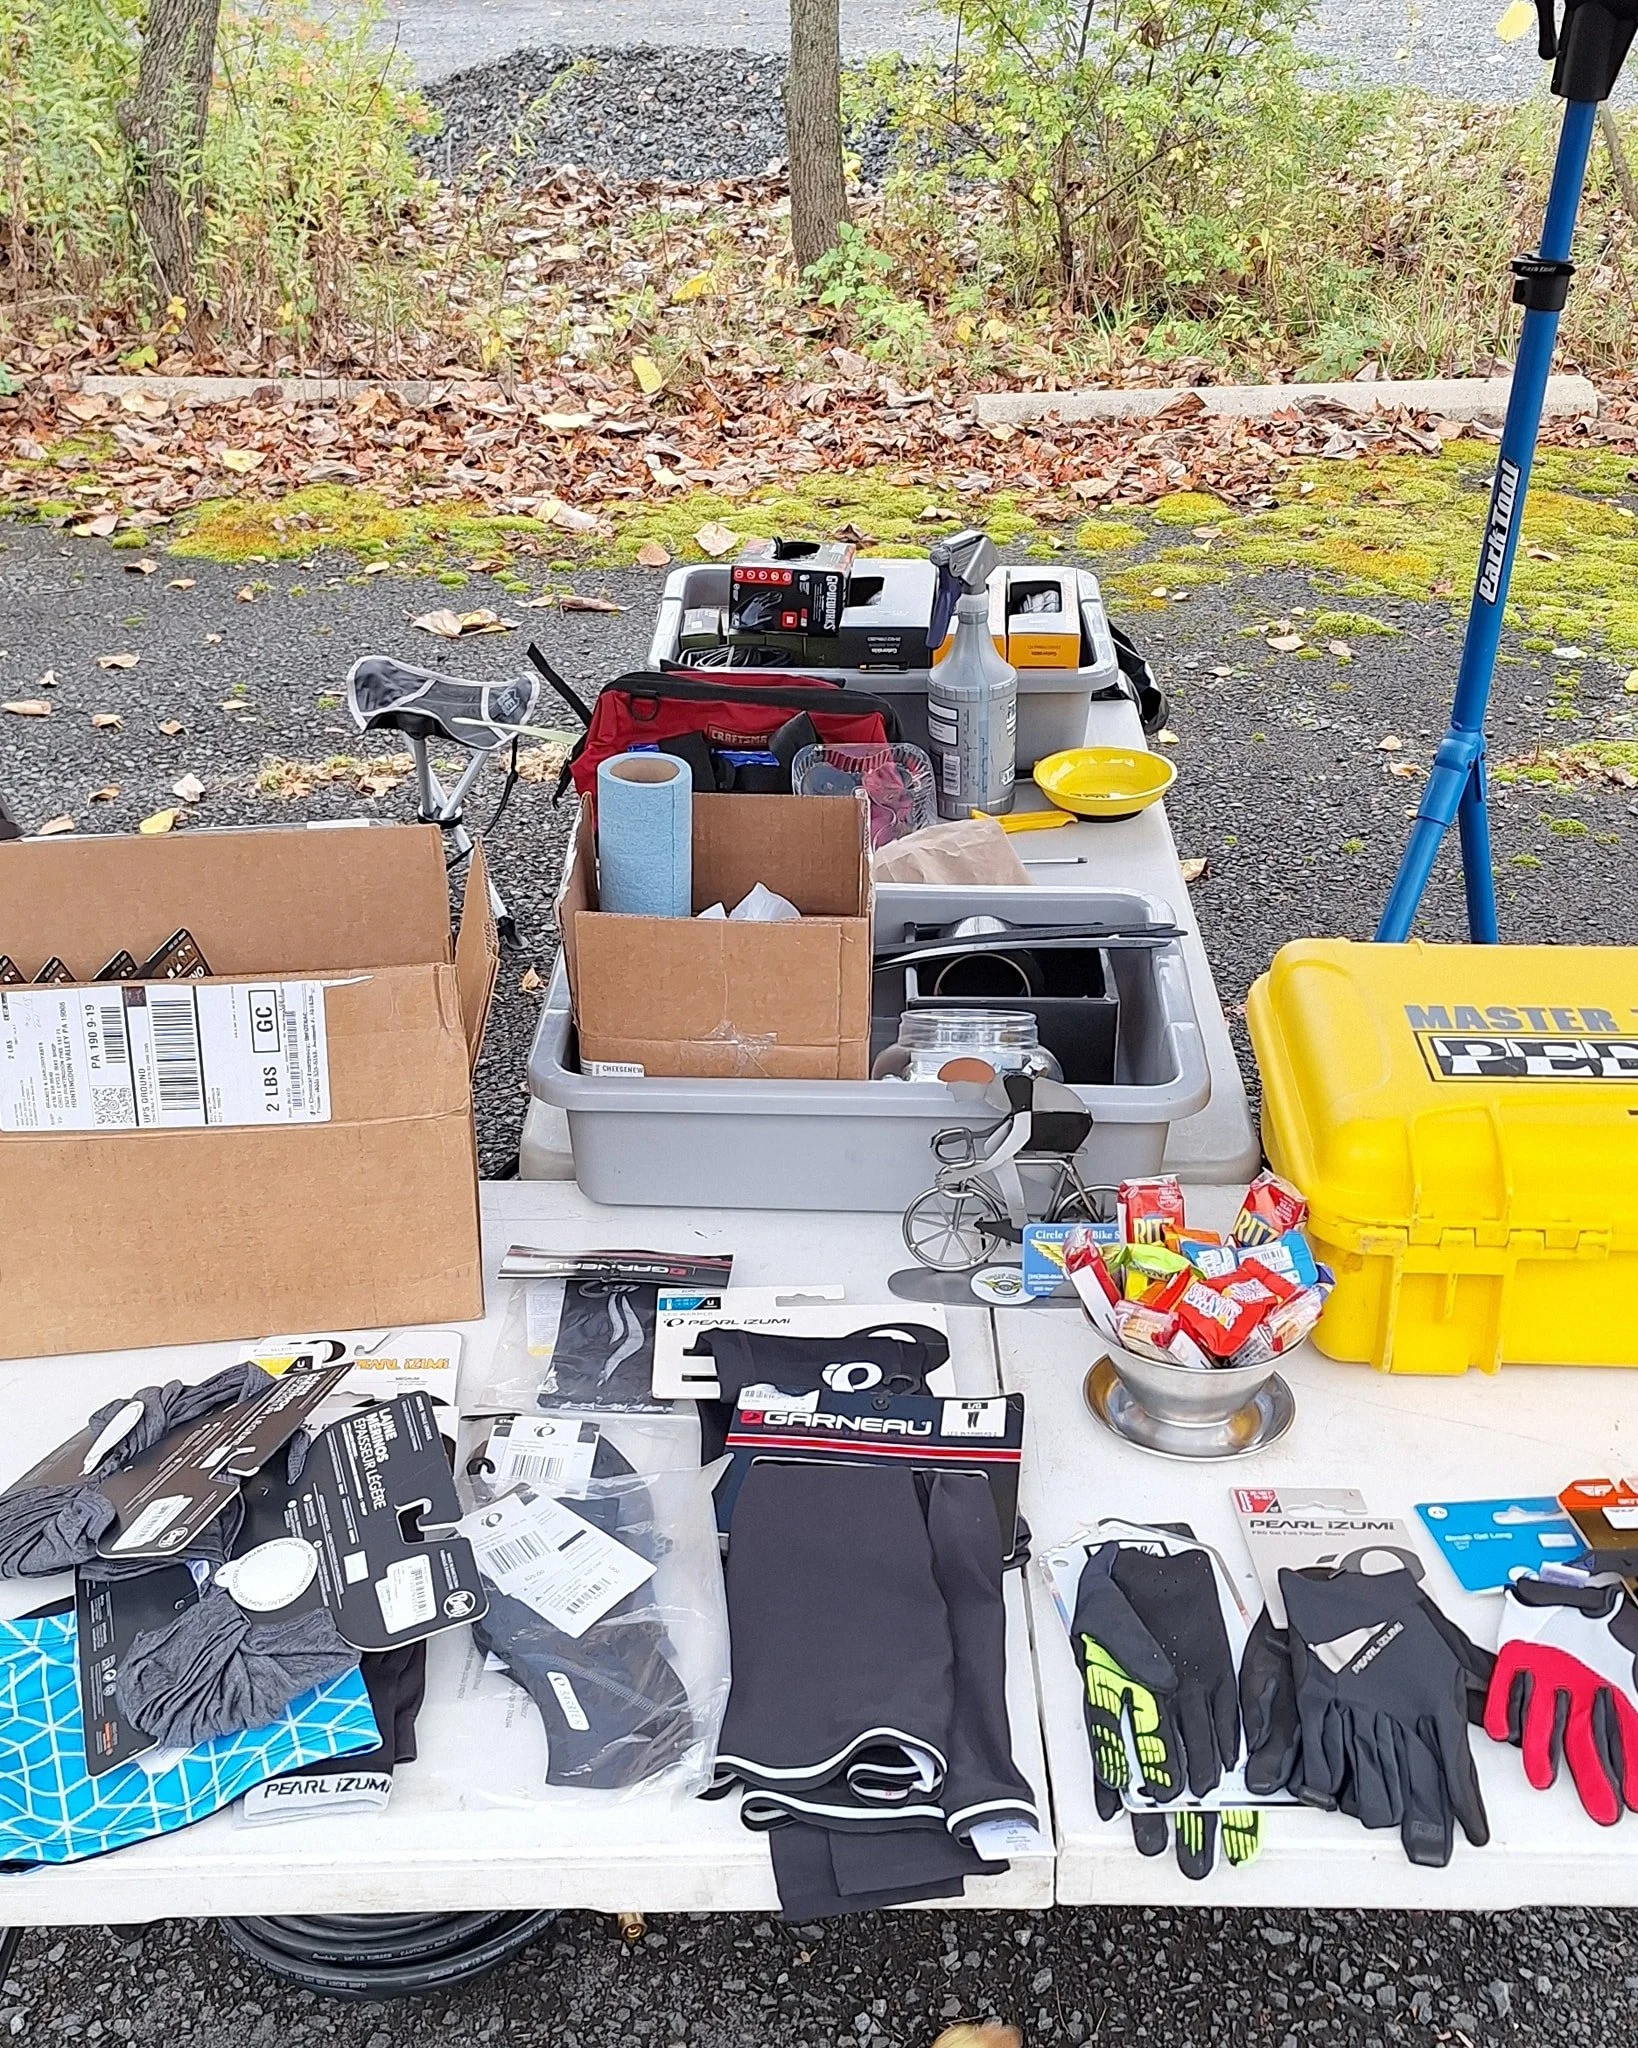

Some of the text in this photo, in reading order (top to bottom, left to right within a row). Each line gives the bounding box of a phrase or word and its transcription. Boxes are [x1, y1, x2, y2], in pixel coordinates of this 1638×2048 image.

[711, 730, 768, 744] CRAFTSMA
[61, 1023, 69, 1033] PA
[255, 1006, 274, 1033] GC
[1404, 1005, 1620, 1032] MASTER
[62, 1035, 73, 1061] VALLEY
[85, 1004, 101, 1069] PA 190 9-19
[138, 1068, 149, 1104] GROUND
[263, 1066, 280, 1112] 2 LBS
[141, 1106, 151, 1123] UPS
[1035, 1230, 1063, 1240] Circle
[1092, 1229, 1113, 1240] Bike
[1236, 1208, 1280, 1246] RITZ
[378, 1407, 398, 1442] LAINE
[762, 1411, 933, 1435] GARNEAU
[1250, 1519, 1324, 1530] PEARL
[1351, 1645, 1381, 1676] PEARL
[264, 1779, 331, 1799] PEARL
